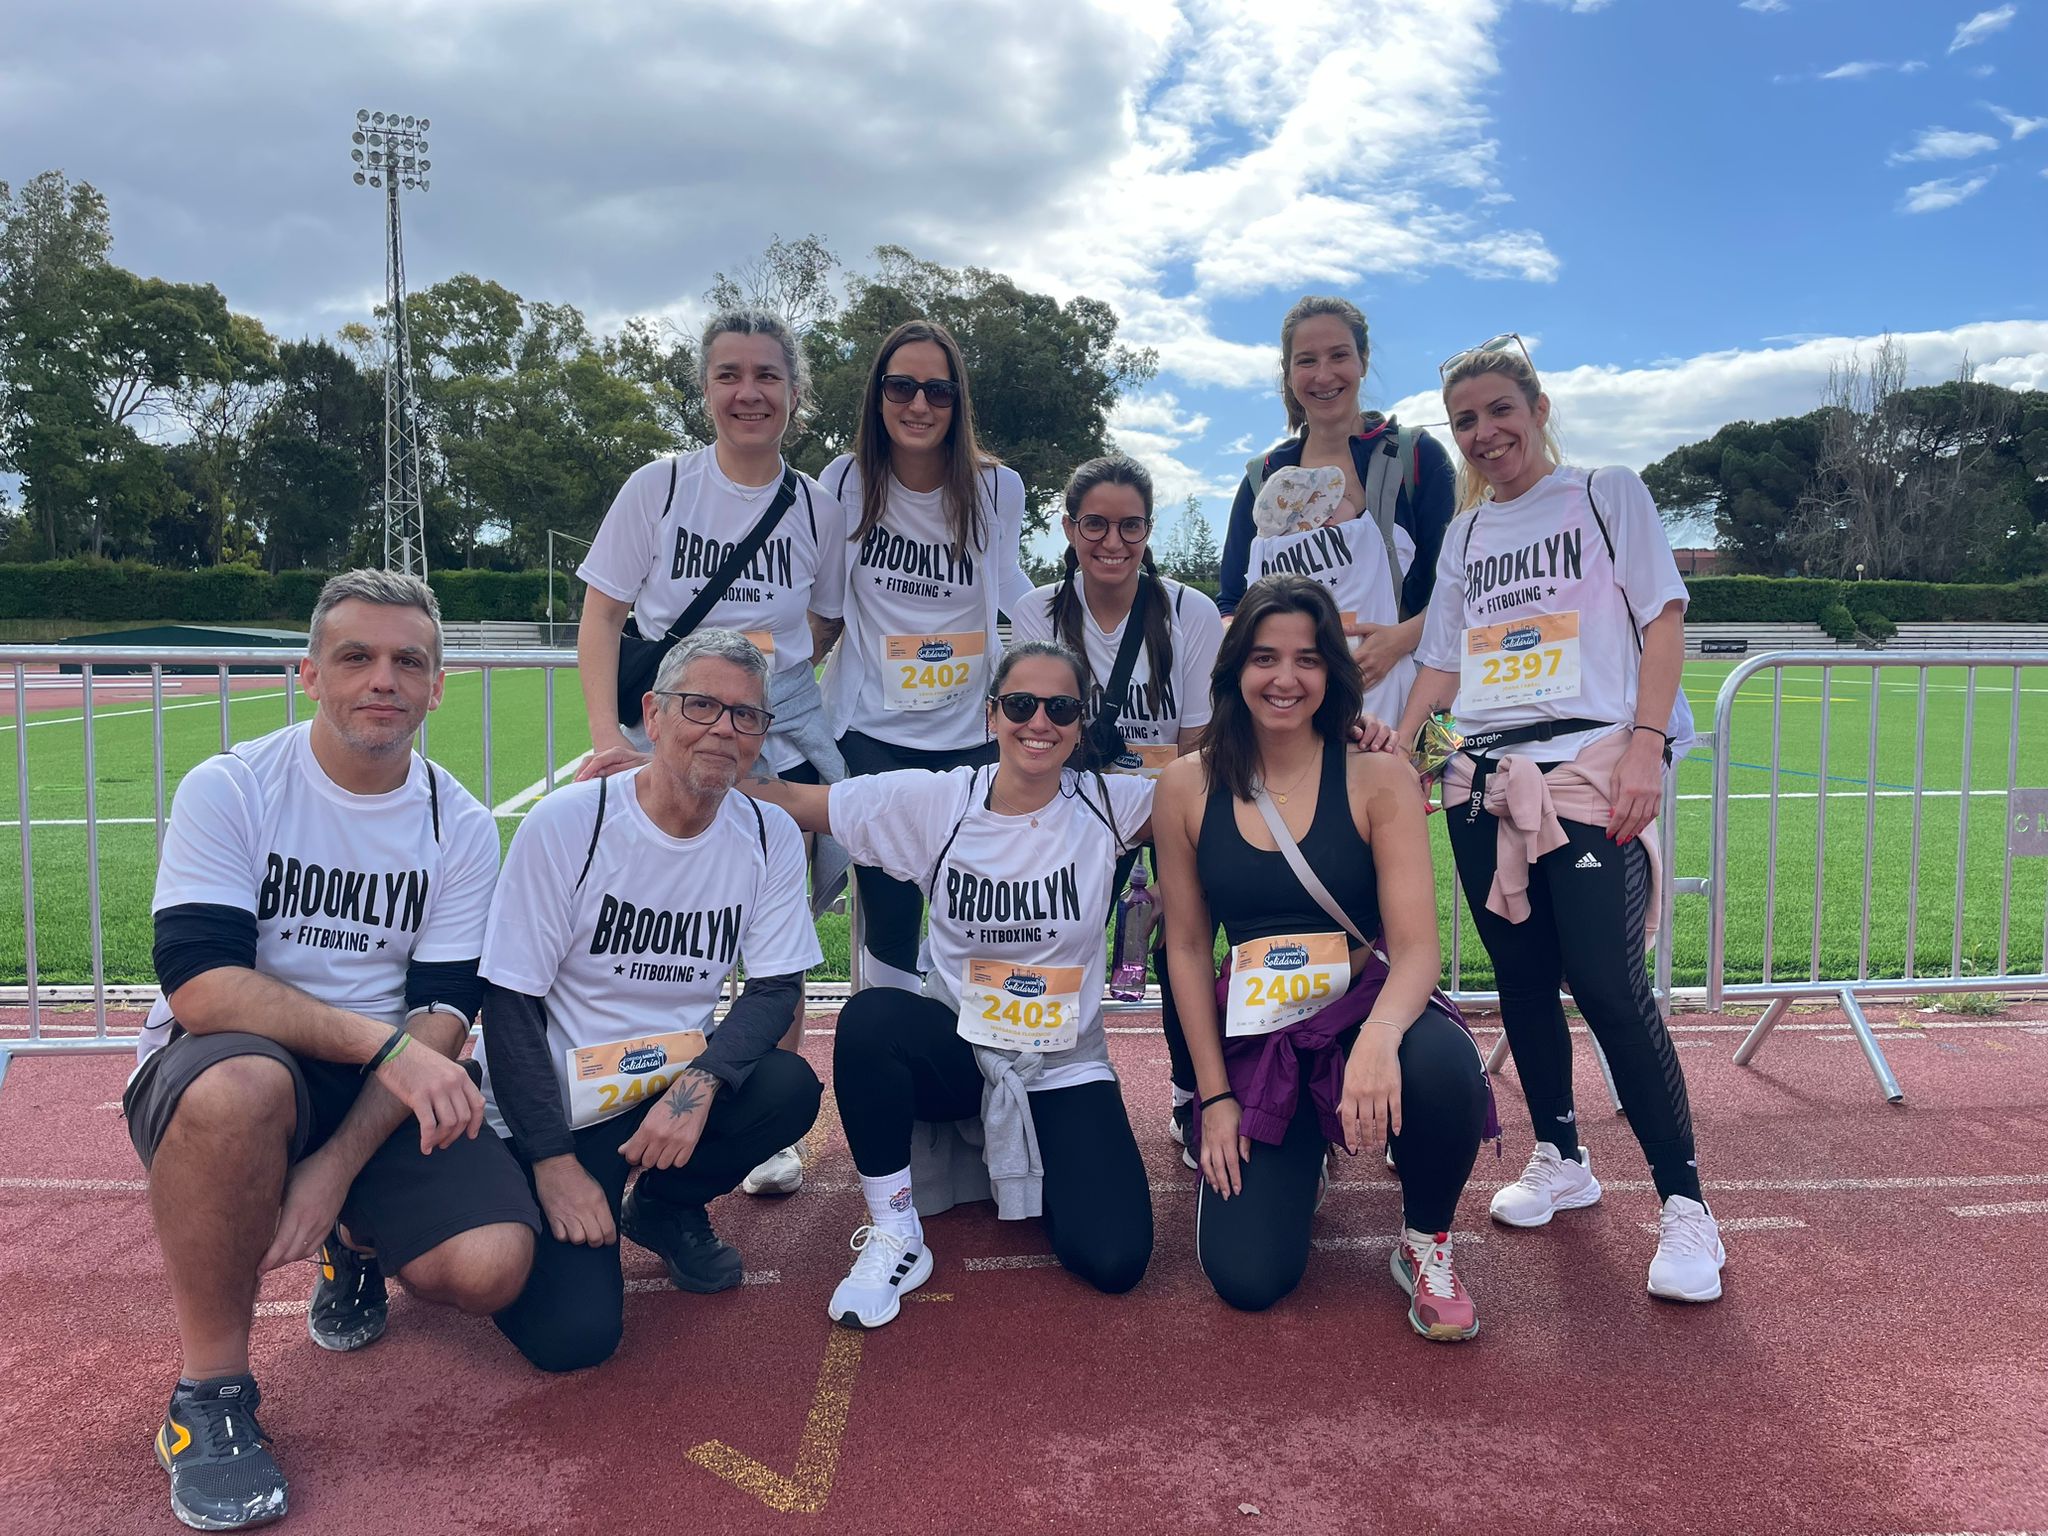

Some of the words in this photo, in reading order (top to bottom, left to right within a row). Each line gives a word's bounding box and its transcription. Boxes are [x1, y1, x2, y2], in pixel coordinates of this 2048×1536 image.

[860, 522, 974, 586] BROOKLYN
[1465, 528, 1582, 608] BROOKLYN
[886, 576, 939, 598] FITBOXING
[1487, 585, 1542, 613] FITBOXING
[1501, 637, 1535, 650] Solidária
[900, 662, 970, 689] 2402
[1481, 648, 1563, 685] 2397
[1469, 791, 1483, 818] gato
[1575, 861, 1602, 869] adidas
[258, 852, 429, 933] BROOKLYN
[947, 862, 1081, 922] BROOKLYN
[297, 926, 369, 952] FITBOXING
[590, 893, 742, 964] BROOKLYN
[980, 928, 1042, 943] FITBOXING
[629, 962, 695, 982] FITBOXING
[1264, 955, 1303, 967] Solidária
[1003, 979, 1039, 993] Solidária
[1245, 973, 1331, 1006] 2405
[982, 994, 1063, 1029] 2403
[618, 1057, 660, 1073] Solidária
